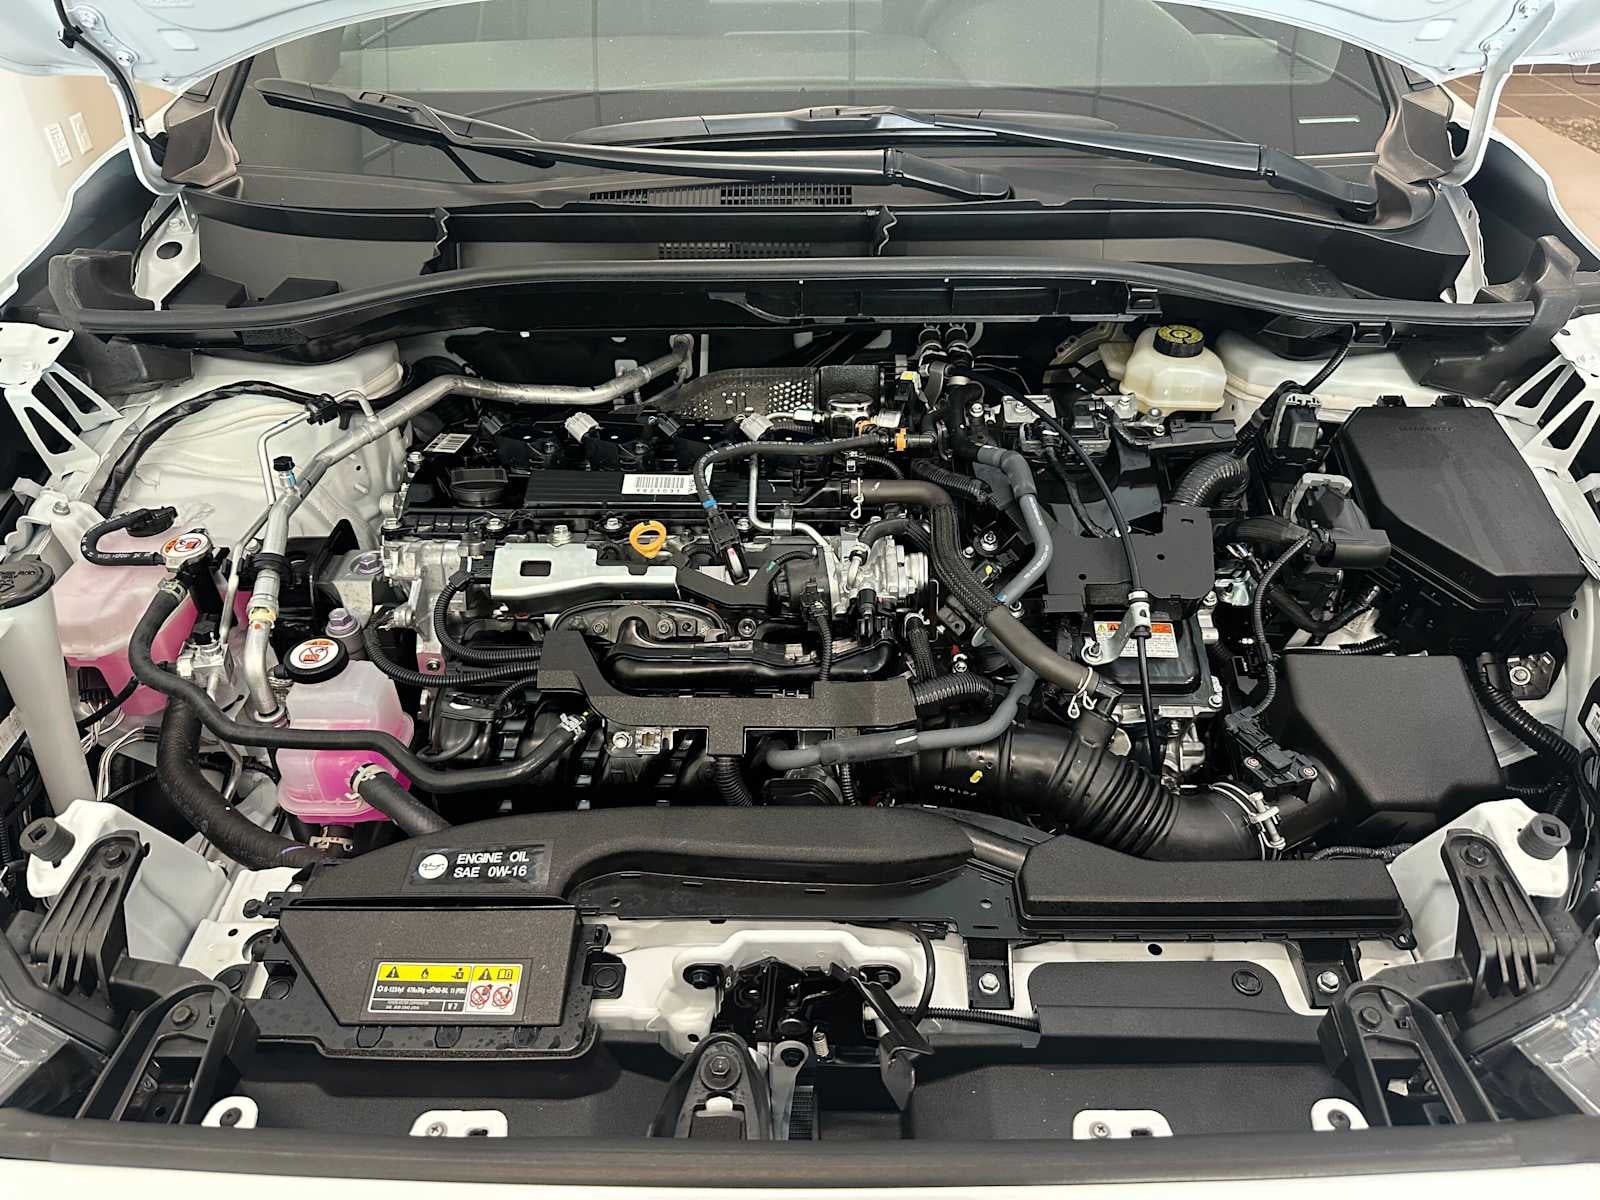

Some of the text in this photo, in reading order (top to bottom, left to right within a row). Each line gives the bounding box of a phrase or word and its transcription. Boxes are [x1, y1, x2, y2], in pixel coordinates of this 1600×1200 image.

[456, 850, 530, 864] ENGINE OIL
[453, 865, 528, 878] SAE 0W-16
